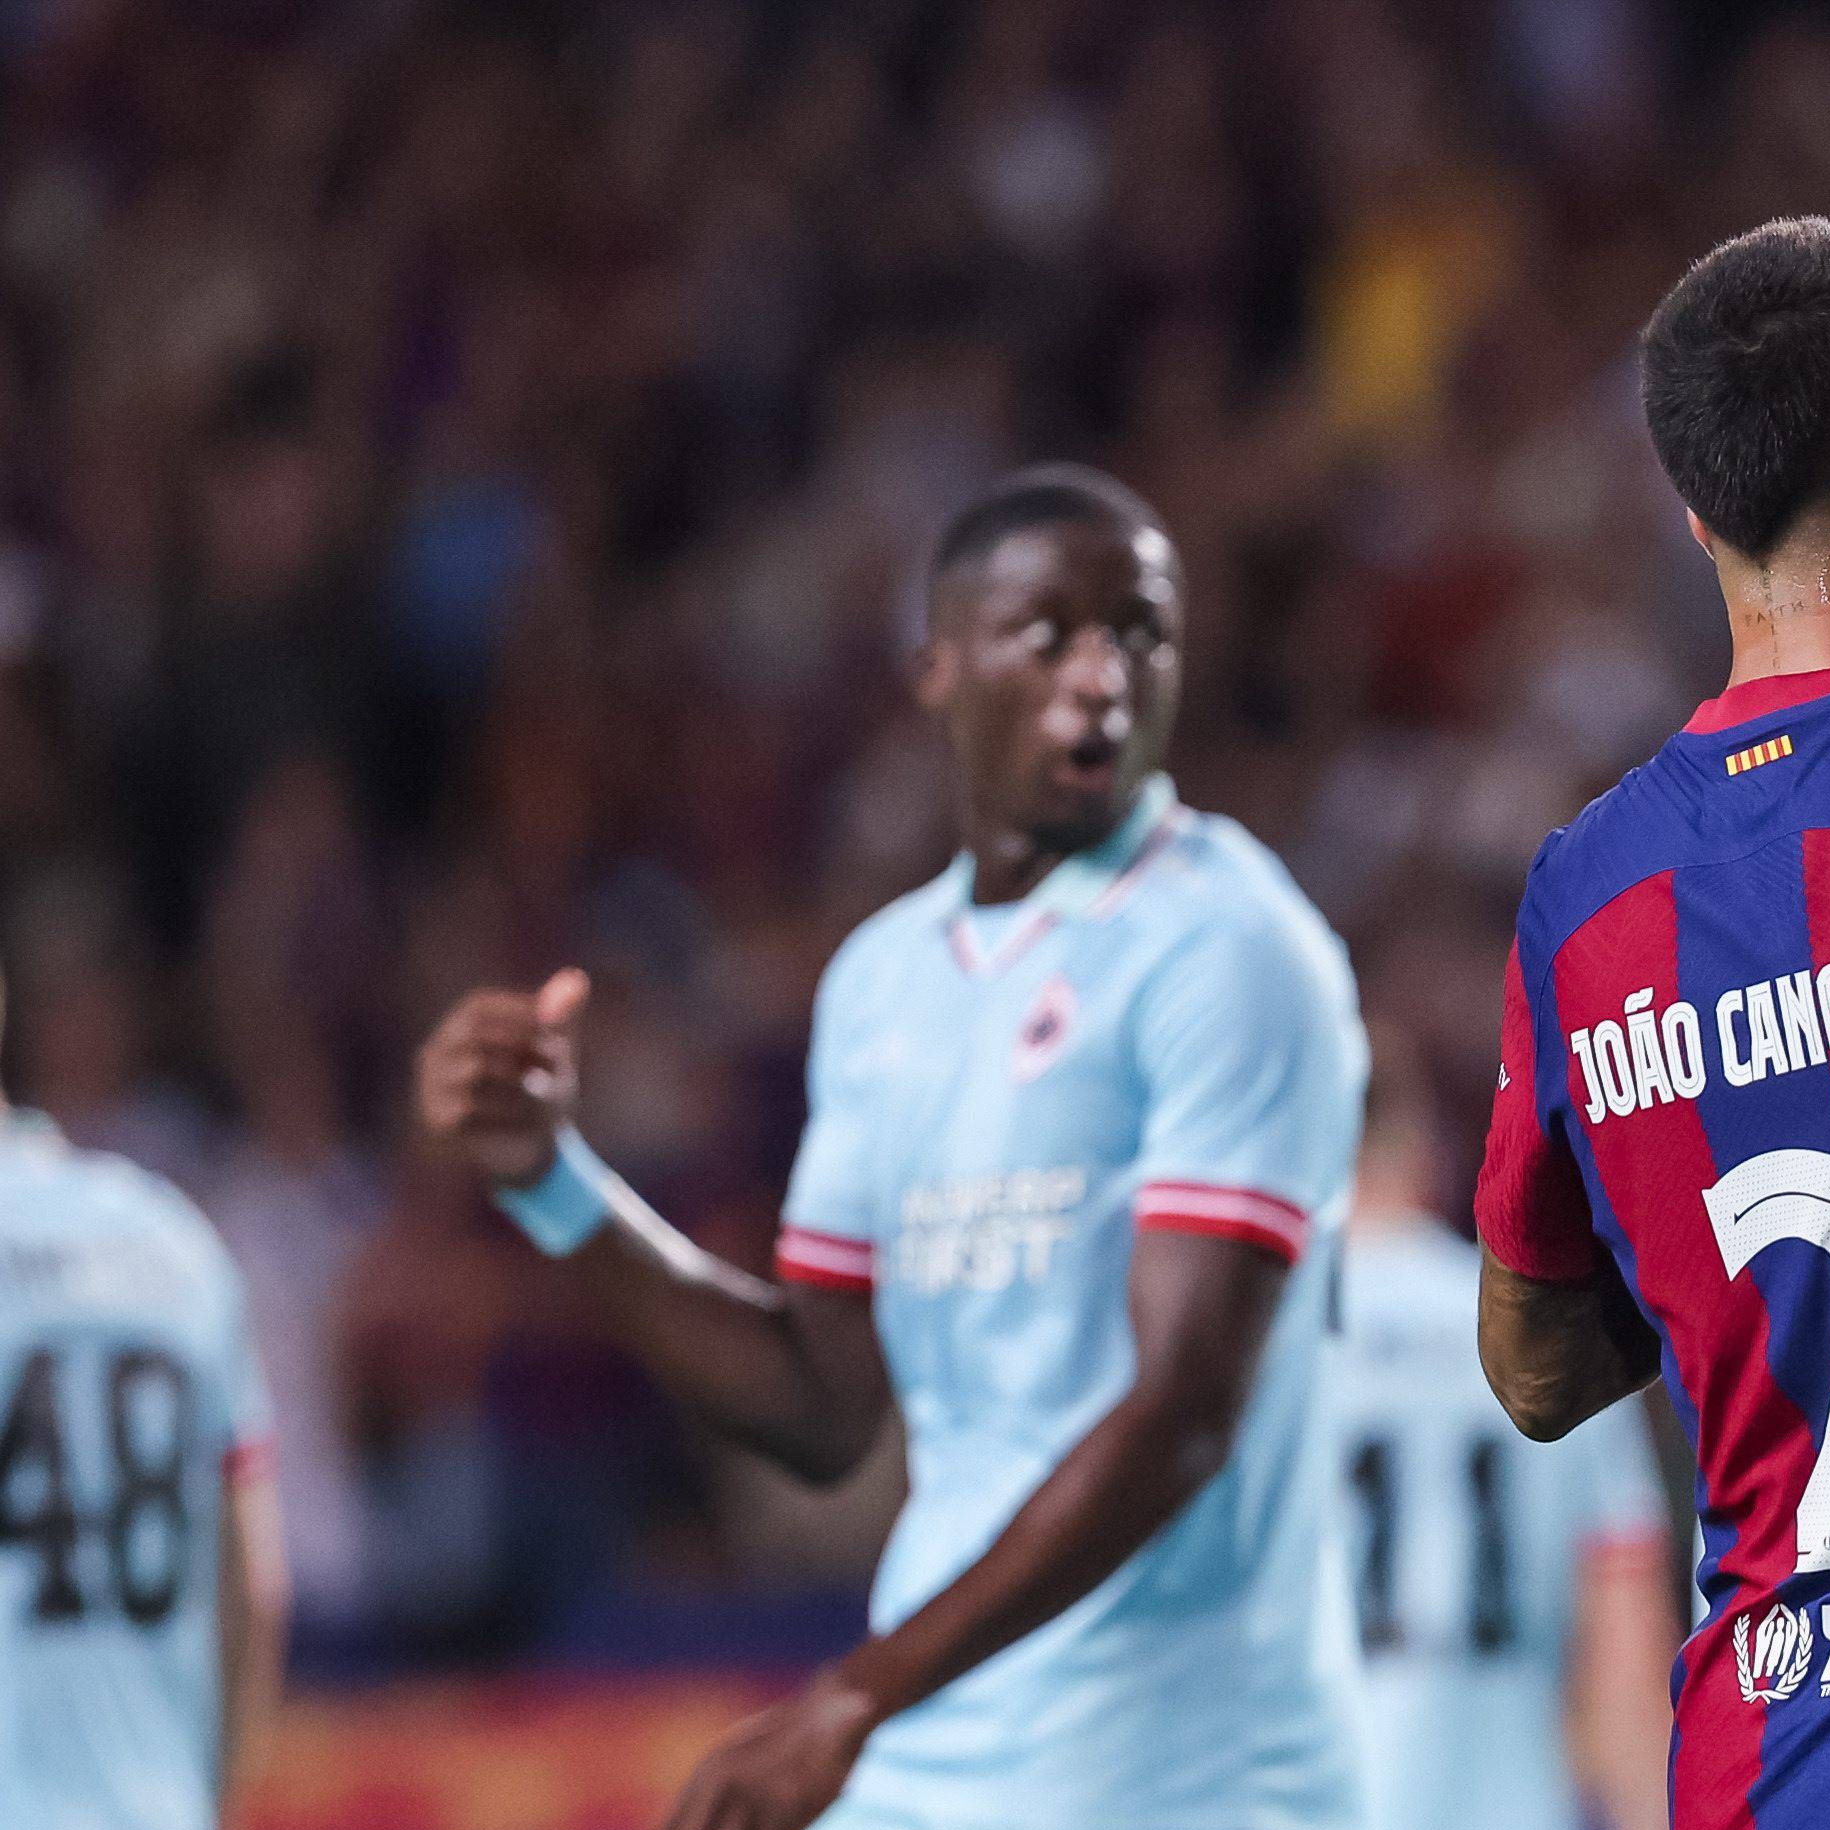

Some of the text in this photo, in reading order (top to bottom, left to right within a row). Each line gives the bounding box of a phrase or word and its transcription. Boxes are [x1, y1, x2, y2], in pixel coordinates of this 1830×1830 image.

[1570, 986, 1707, 1124] JOÃO
[0, 1345, 187, 1628] 48
[1346, 1430, 1514, 1657] 11
